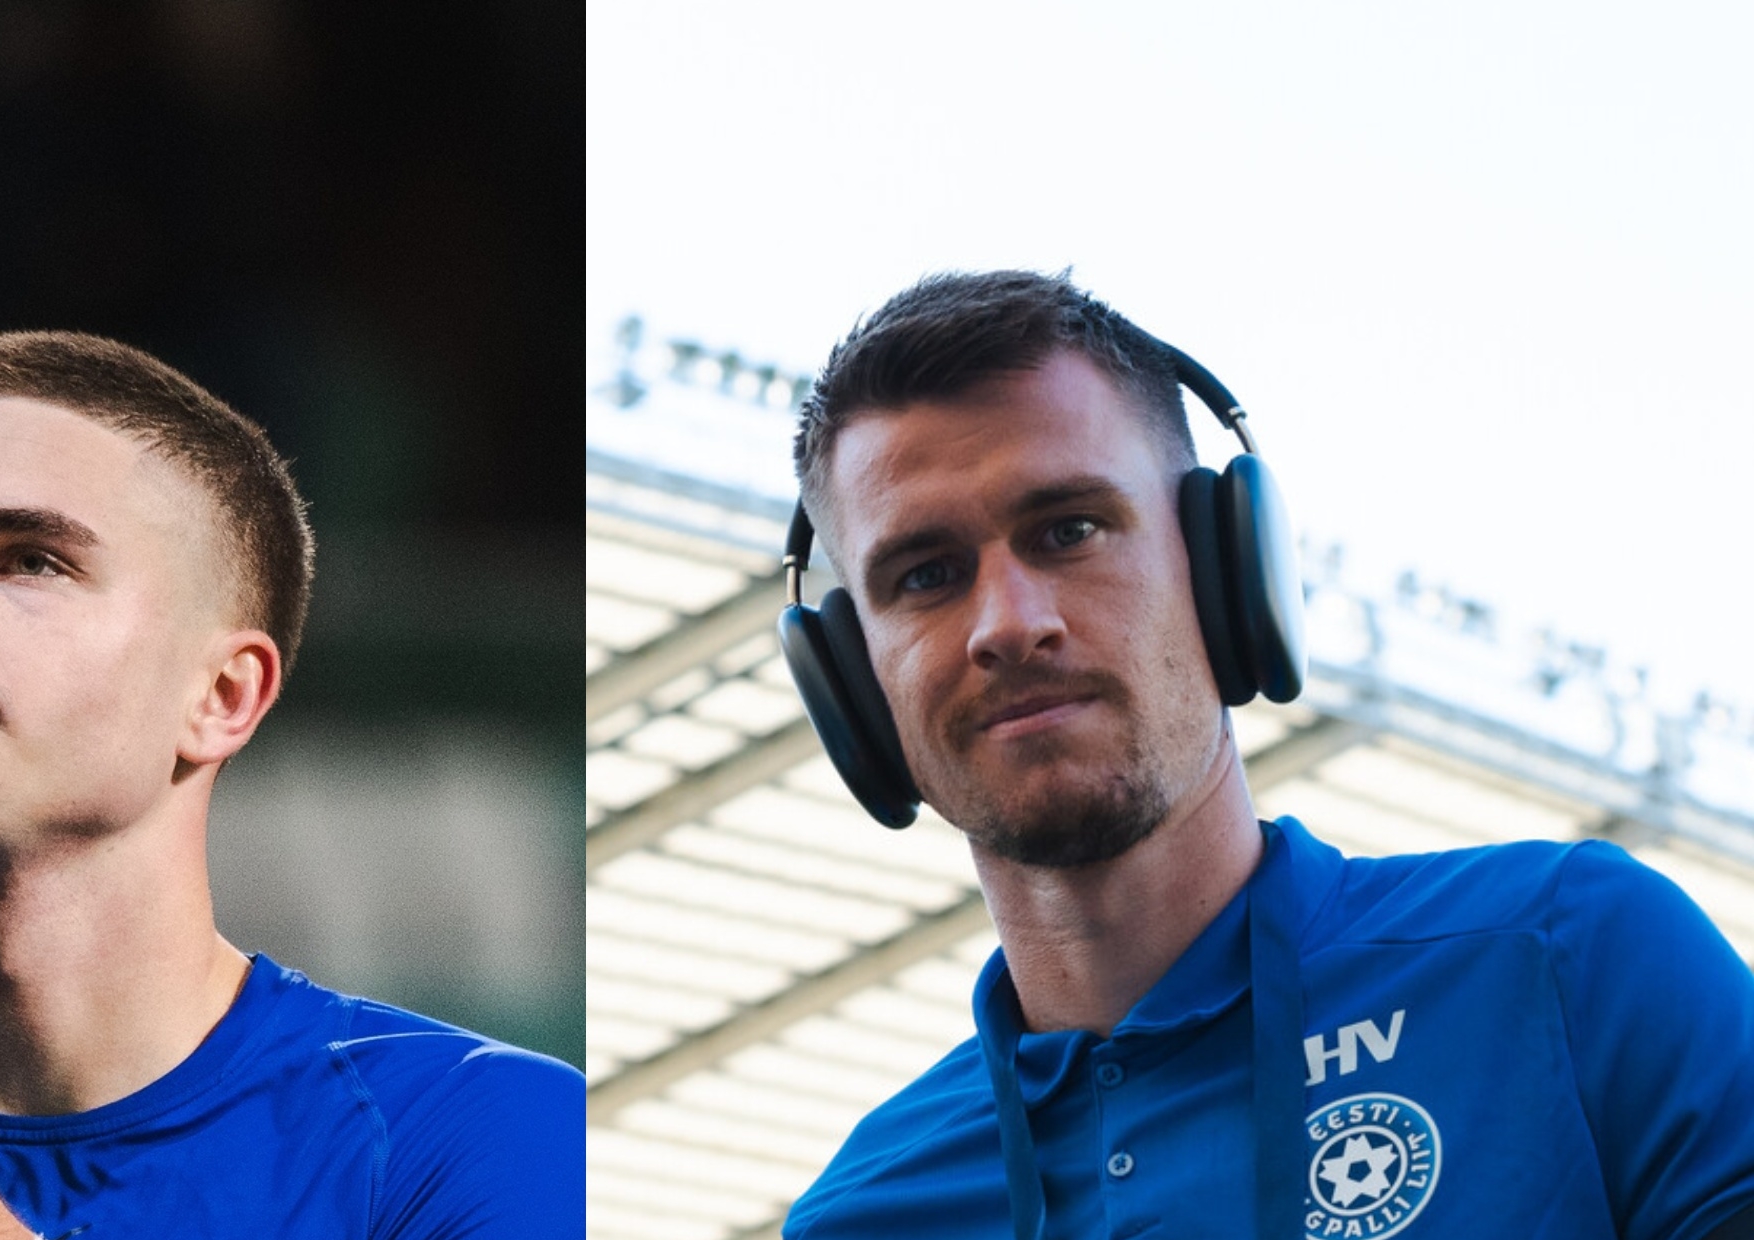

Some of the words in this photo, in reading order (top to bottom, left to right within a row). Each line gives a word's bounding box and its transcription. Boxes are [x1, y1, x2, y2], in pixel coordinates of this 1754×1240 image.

[1307, 1102, 1399, 1142] EESTI
[1304, 1195, 1411, 1239] GPALLI
[1406, 1131, 1431, 1189] LIIT
